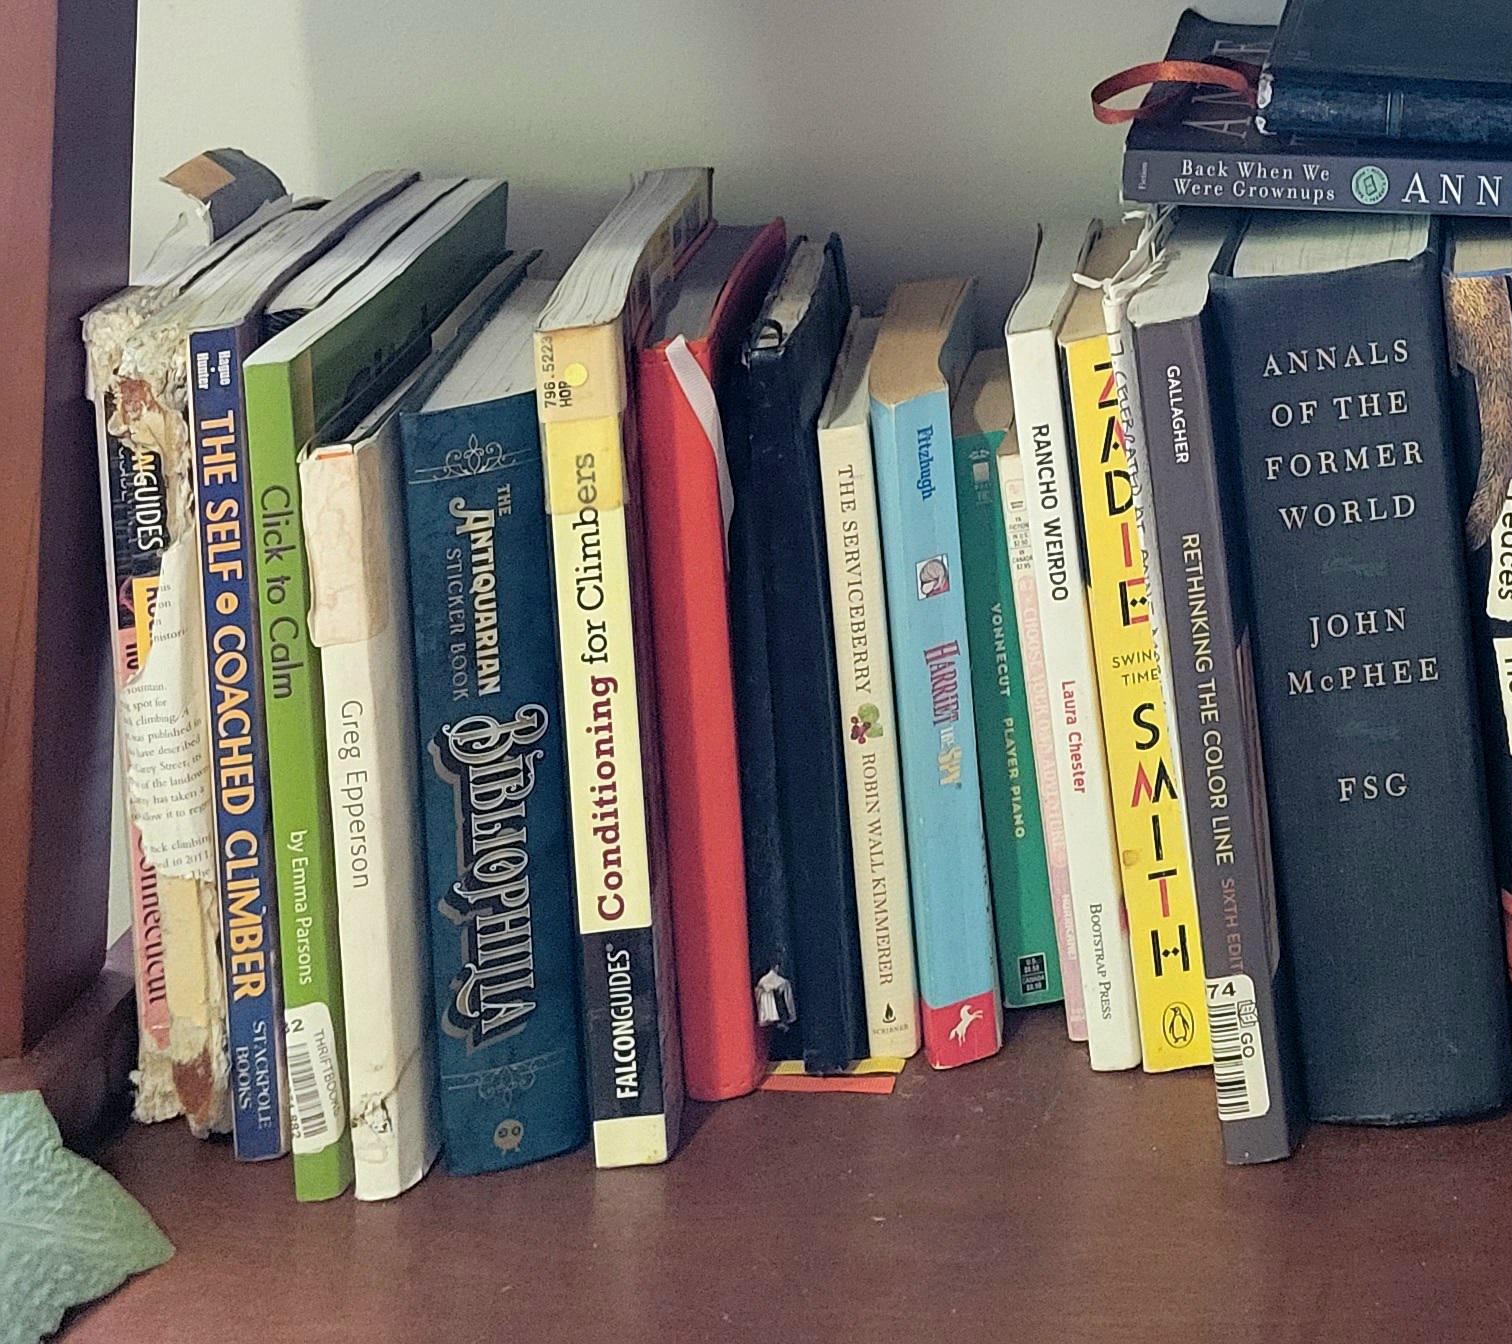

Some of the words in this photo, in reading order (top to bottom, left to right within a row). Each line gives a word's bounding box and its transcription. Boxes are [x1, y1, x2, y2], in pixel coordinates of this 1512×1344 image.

[1263, 340, 1409, 377] ANNALS
[1167, 365, 1190, 462] GALLAGHER
[1272, 398, 1316, 428] OF
[1334, 390, 1408, 423] THE
[201, 409, 240, 492] THE
[1031, 424, 1059, 509] RANCHO
[1266, 441, 1424, 481] FORMER
[204, 499, 244, 581] SELF
[260, 485, 294, 566] Click
[1279, 493, 1417, 531] WORLD
[1042, 518, 1068, 600] WEIRDO
[269, 577, 295, 608] to
[1310, 608, 1407, 647] JOHN
[267, 619, 300, 698] Calm
[1289, 657, 1440, 697] McPHEE
[214, 625, 256, 815] COACHED
[339, 700, 366, 760] Greg
[1061, 680, 1080, 730] Laura
[1066, 737, 1089, 793] Chester
[1339, 773, 1408, 803] FSG
[288, 831, 310, 851] by
[340, 770, 374, 888] Epperson
[292, 857, 313, 908] Emma
[225, 830, 267, 1000] CLIMBER
[295, 916, 317, 984] Parsons
